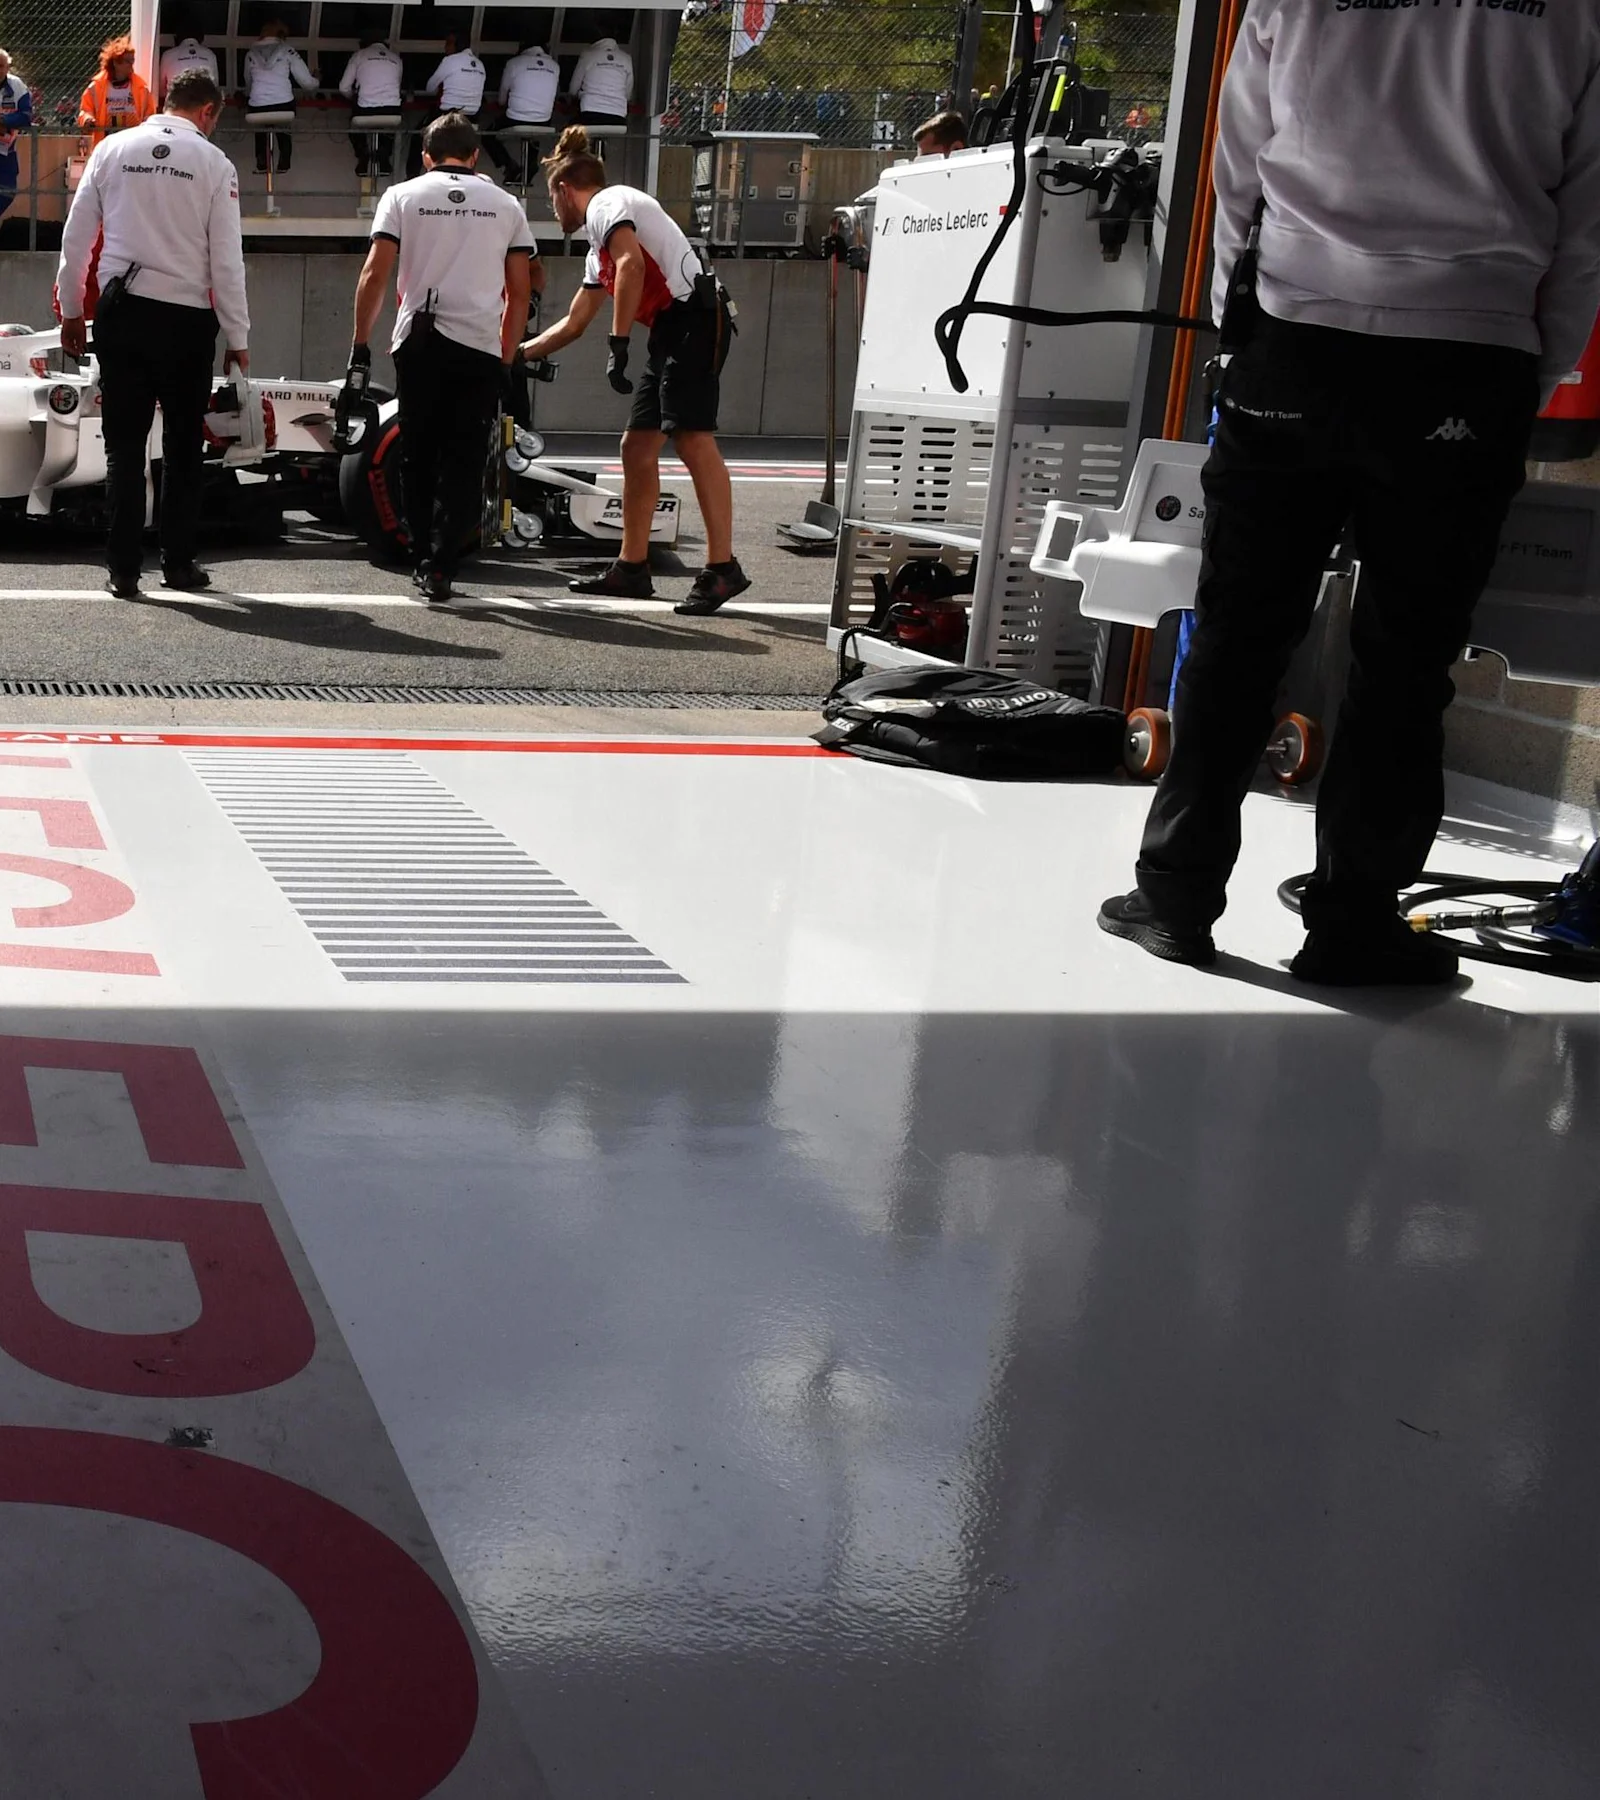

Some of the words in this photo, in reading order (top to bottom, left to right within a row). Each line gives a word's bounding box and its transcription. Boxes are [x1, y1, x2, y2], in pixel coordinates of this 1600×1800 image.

[122, 164, 153, 174] Sauber
[169, 167, 194, 181] Team
[419, 207, 452, 216] Sauber
[471, 209, 497, 219] Team
[902, 213, 943, 235] Charles
[946, 208, 989, 230] Leclerc
[1534, 544, 1573, 560] Team
